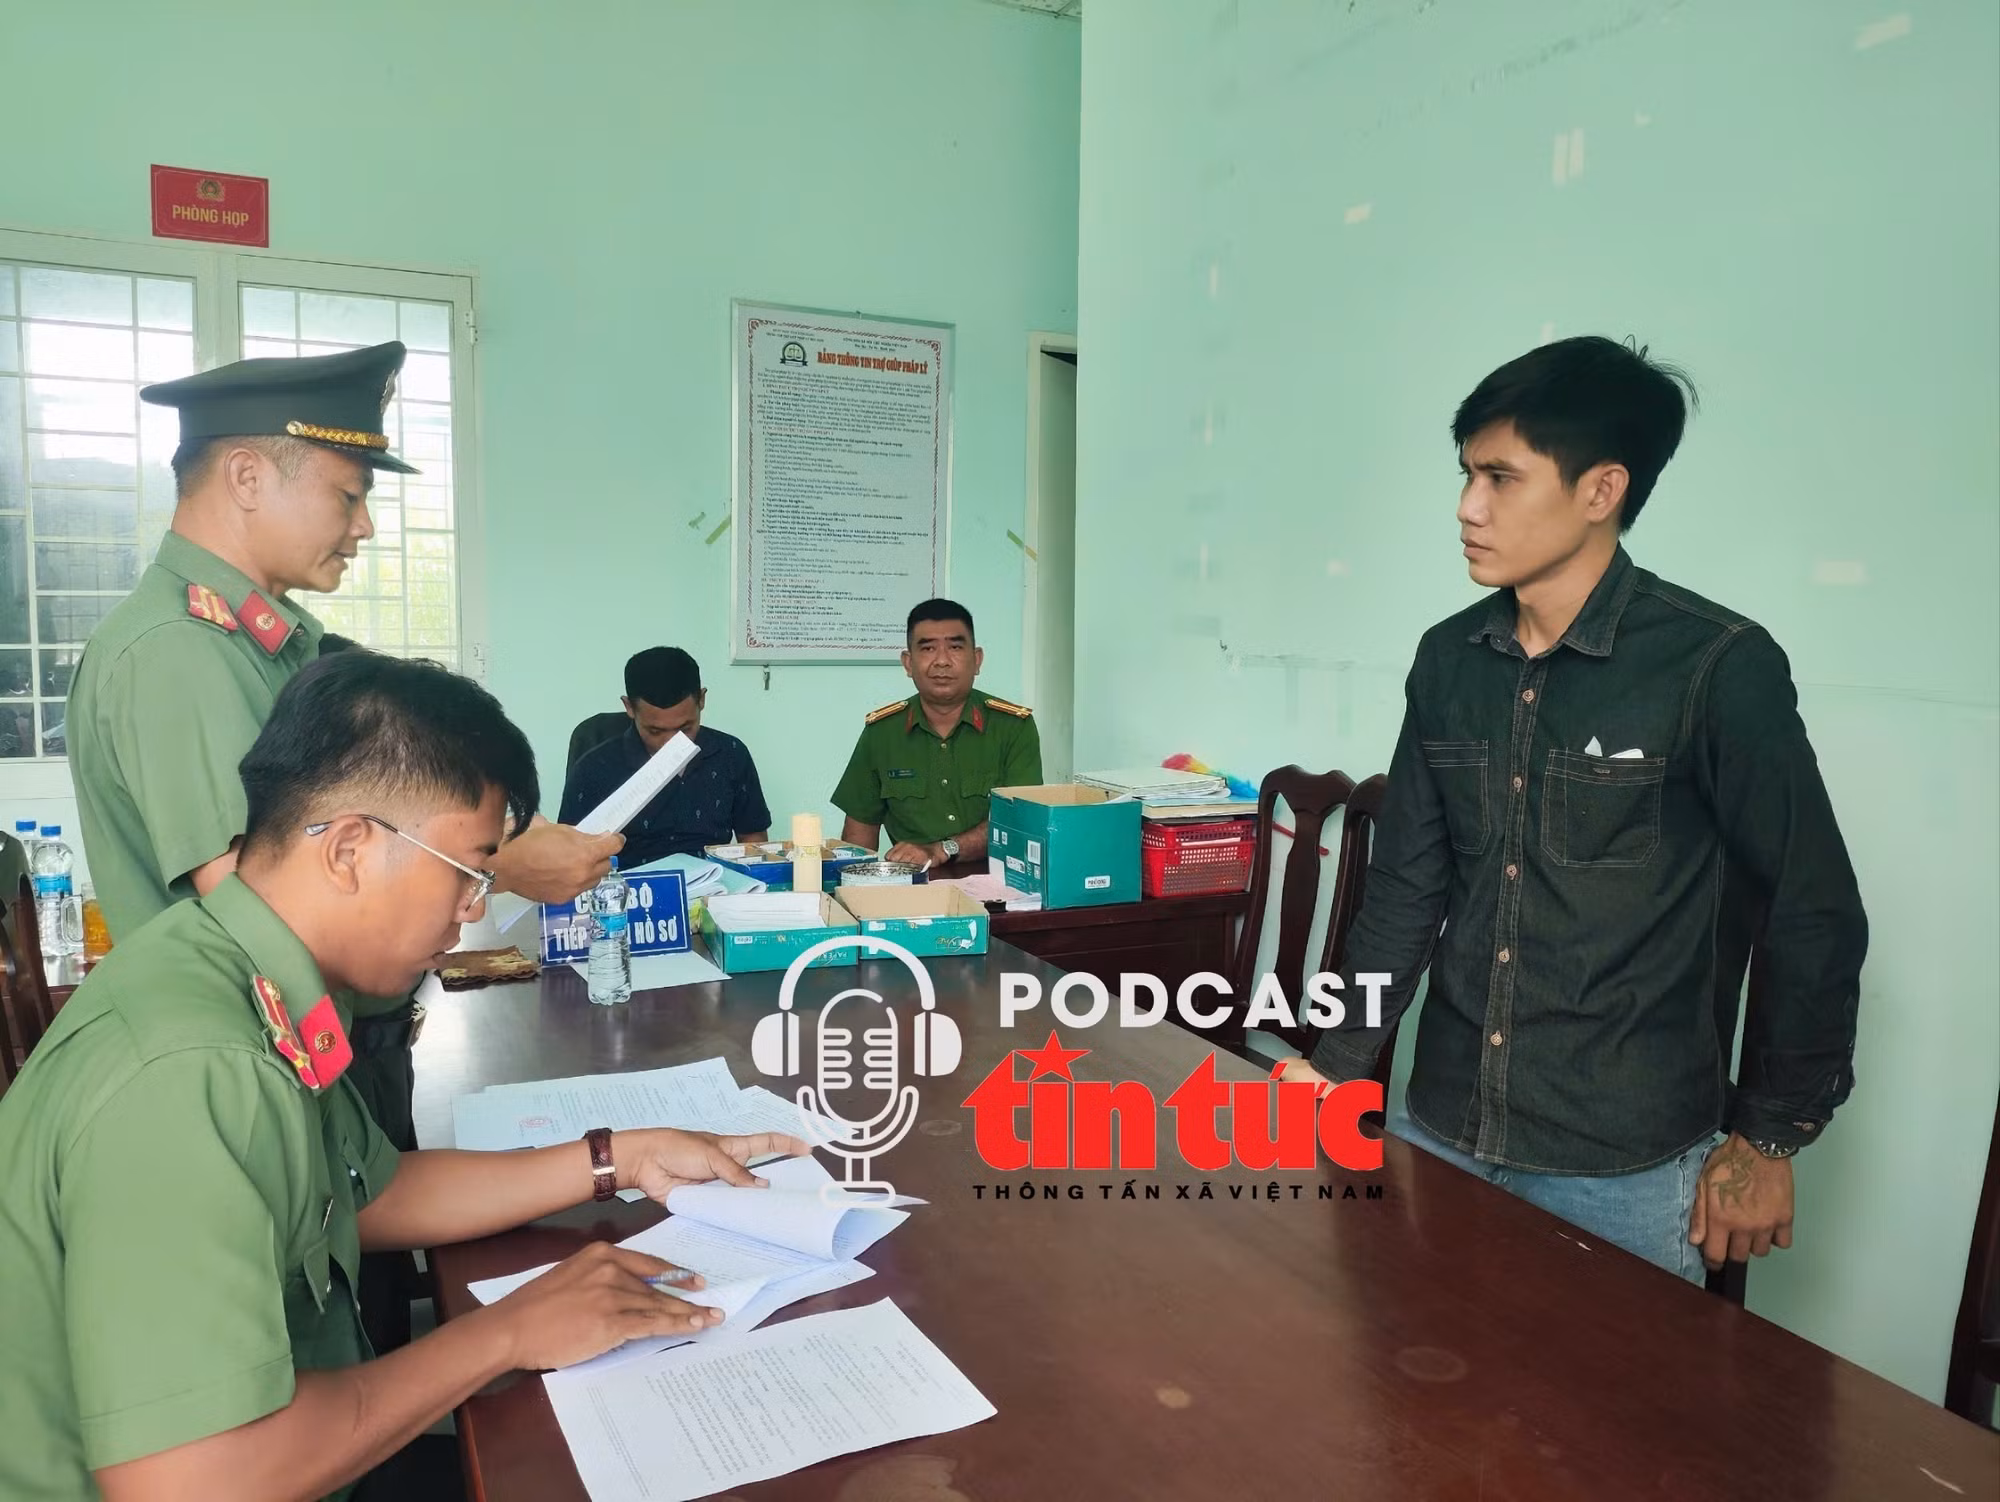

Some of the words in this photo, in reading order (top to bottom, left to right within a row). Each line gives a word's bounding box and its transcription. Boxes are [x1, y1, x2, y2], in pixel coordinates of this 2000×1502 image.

[172, 204, 218, 223] PHÒNG
[222, 210, 249, 228] HỌP
[817, 347, 837, 364] BẢNG
[837, 352, 860, 368] THÔNG
[860, 356, 872, 368] TIN
[872, 357, 886, 372] TRỢ
[886, 358, 902, 372] GIÚP
[902, 359, 919, 374] PHÁP
[919, 361, 928, 375] LÝ
[627, 882, 653, 912] BỘ
[553, 920, 588, 951] TIẾP
[634, 914, 655, 944] HỒ
[657, 915, 678, 942] SƠ
